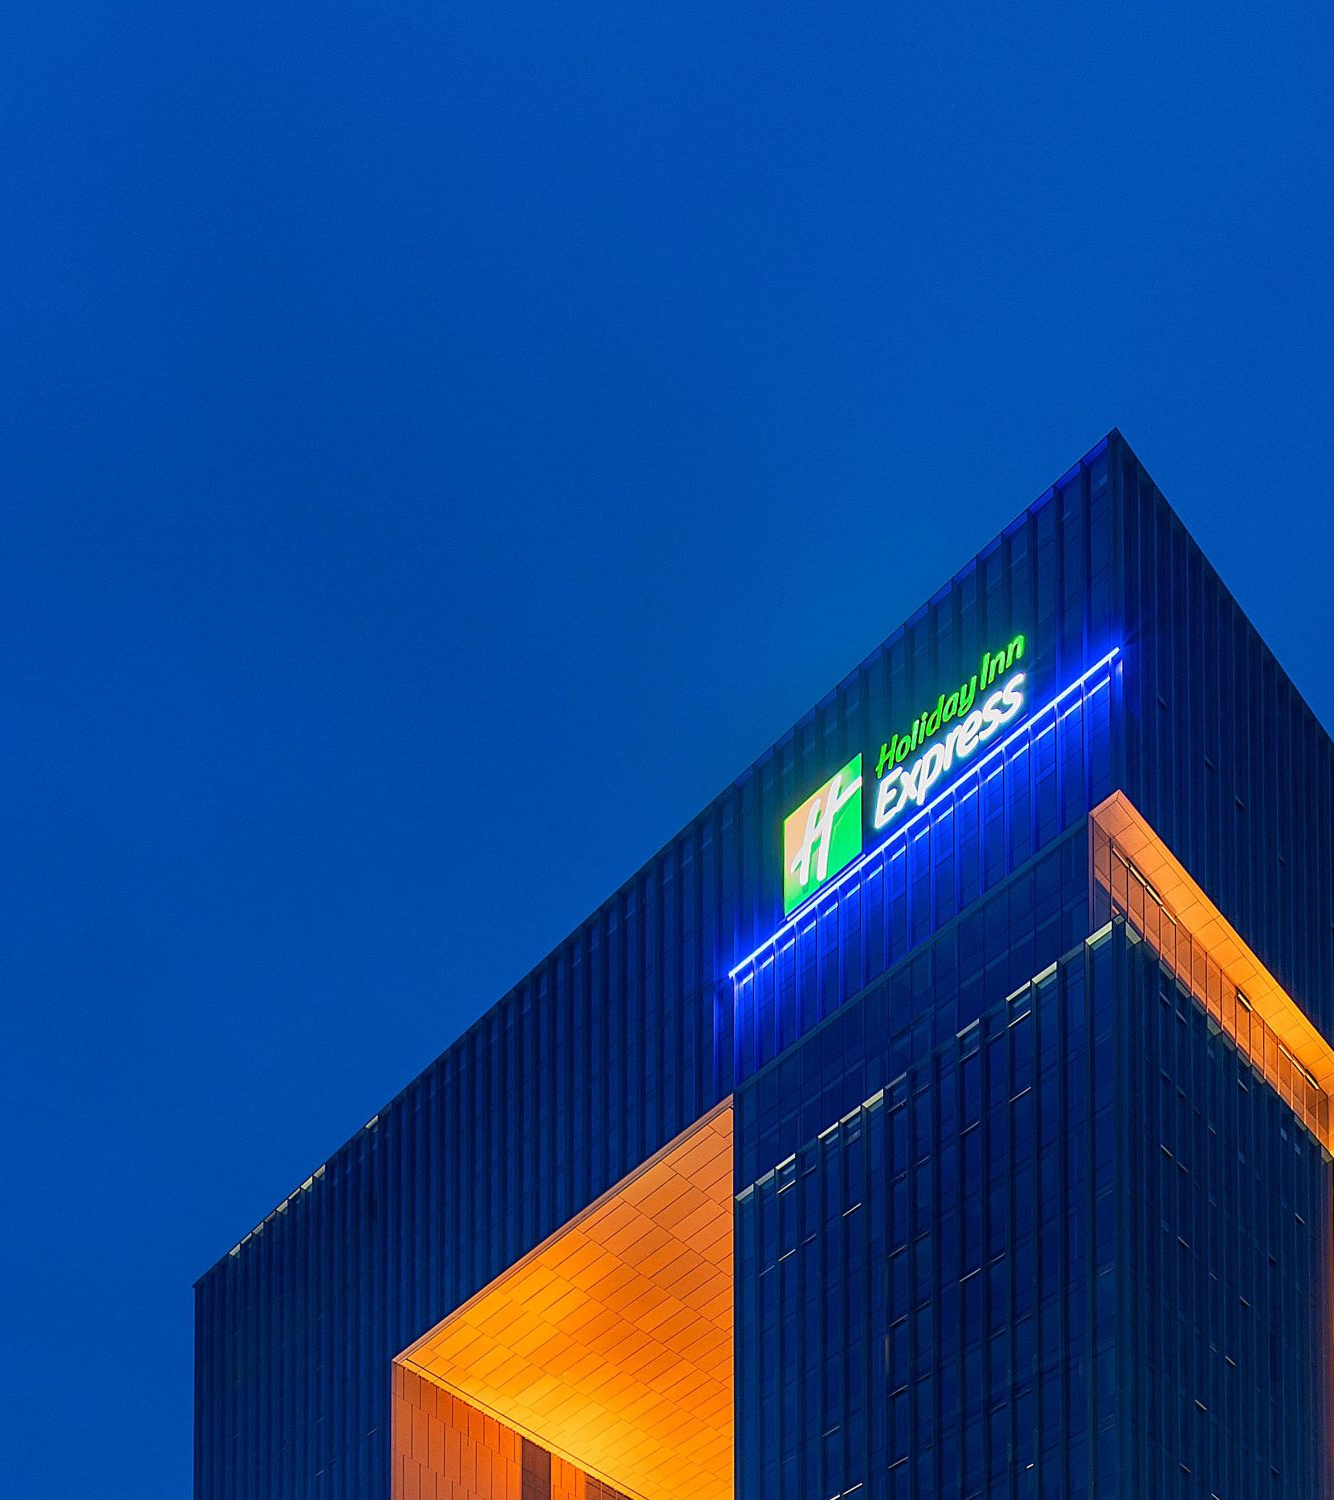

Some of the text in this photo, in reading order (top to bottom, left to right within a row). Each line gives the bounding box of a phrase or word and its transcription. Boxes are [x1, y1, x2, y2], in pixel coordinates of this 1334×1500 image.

[874, 672, 1026, 829] Express
[875, 634, 1025, 779] Holiday Inn
